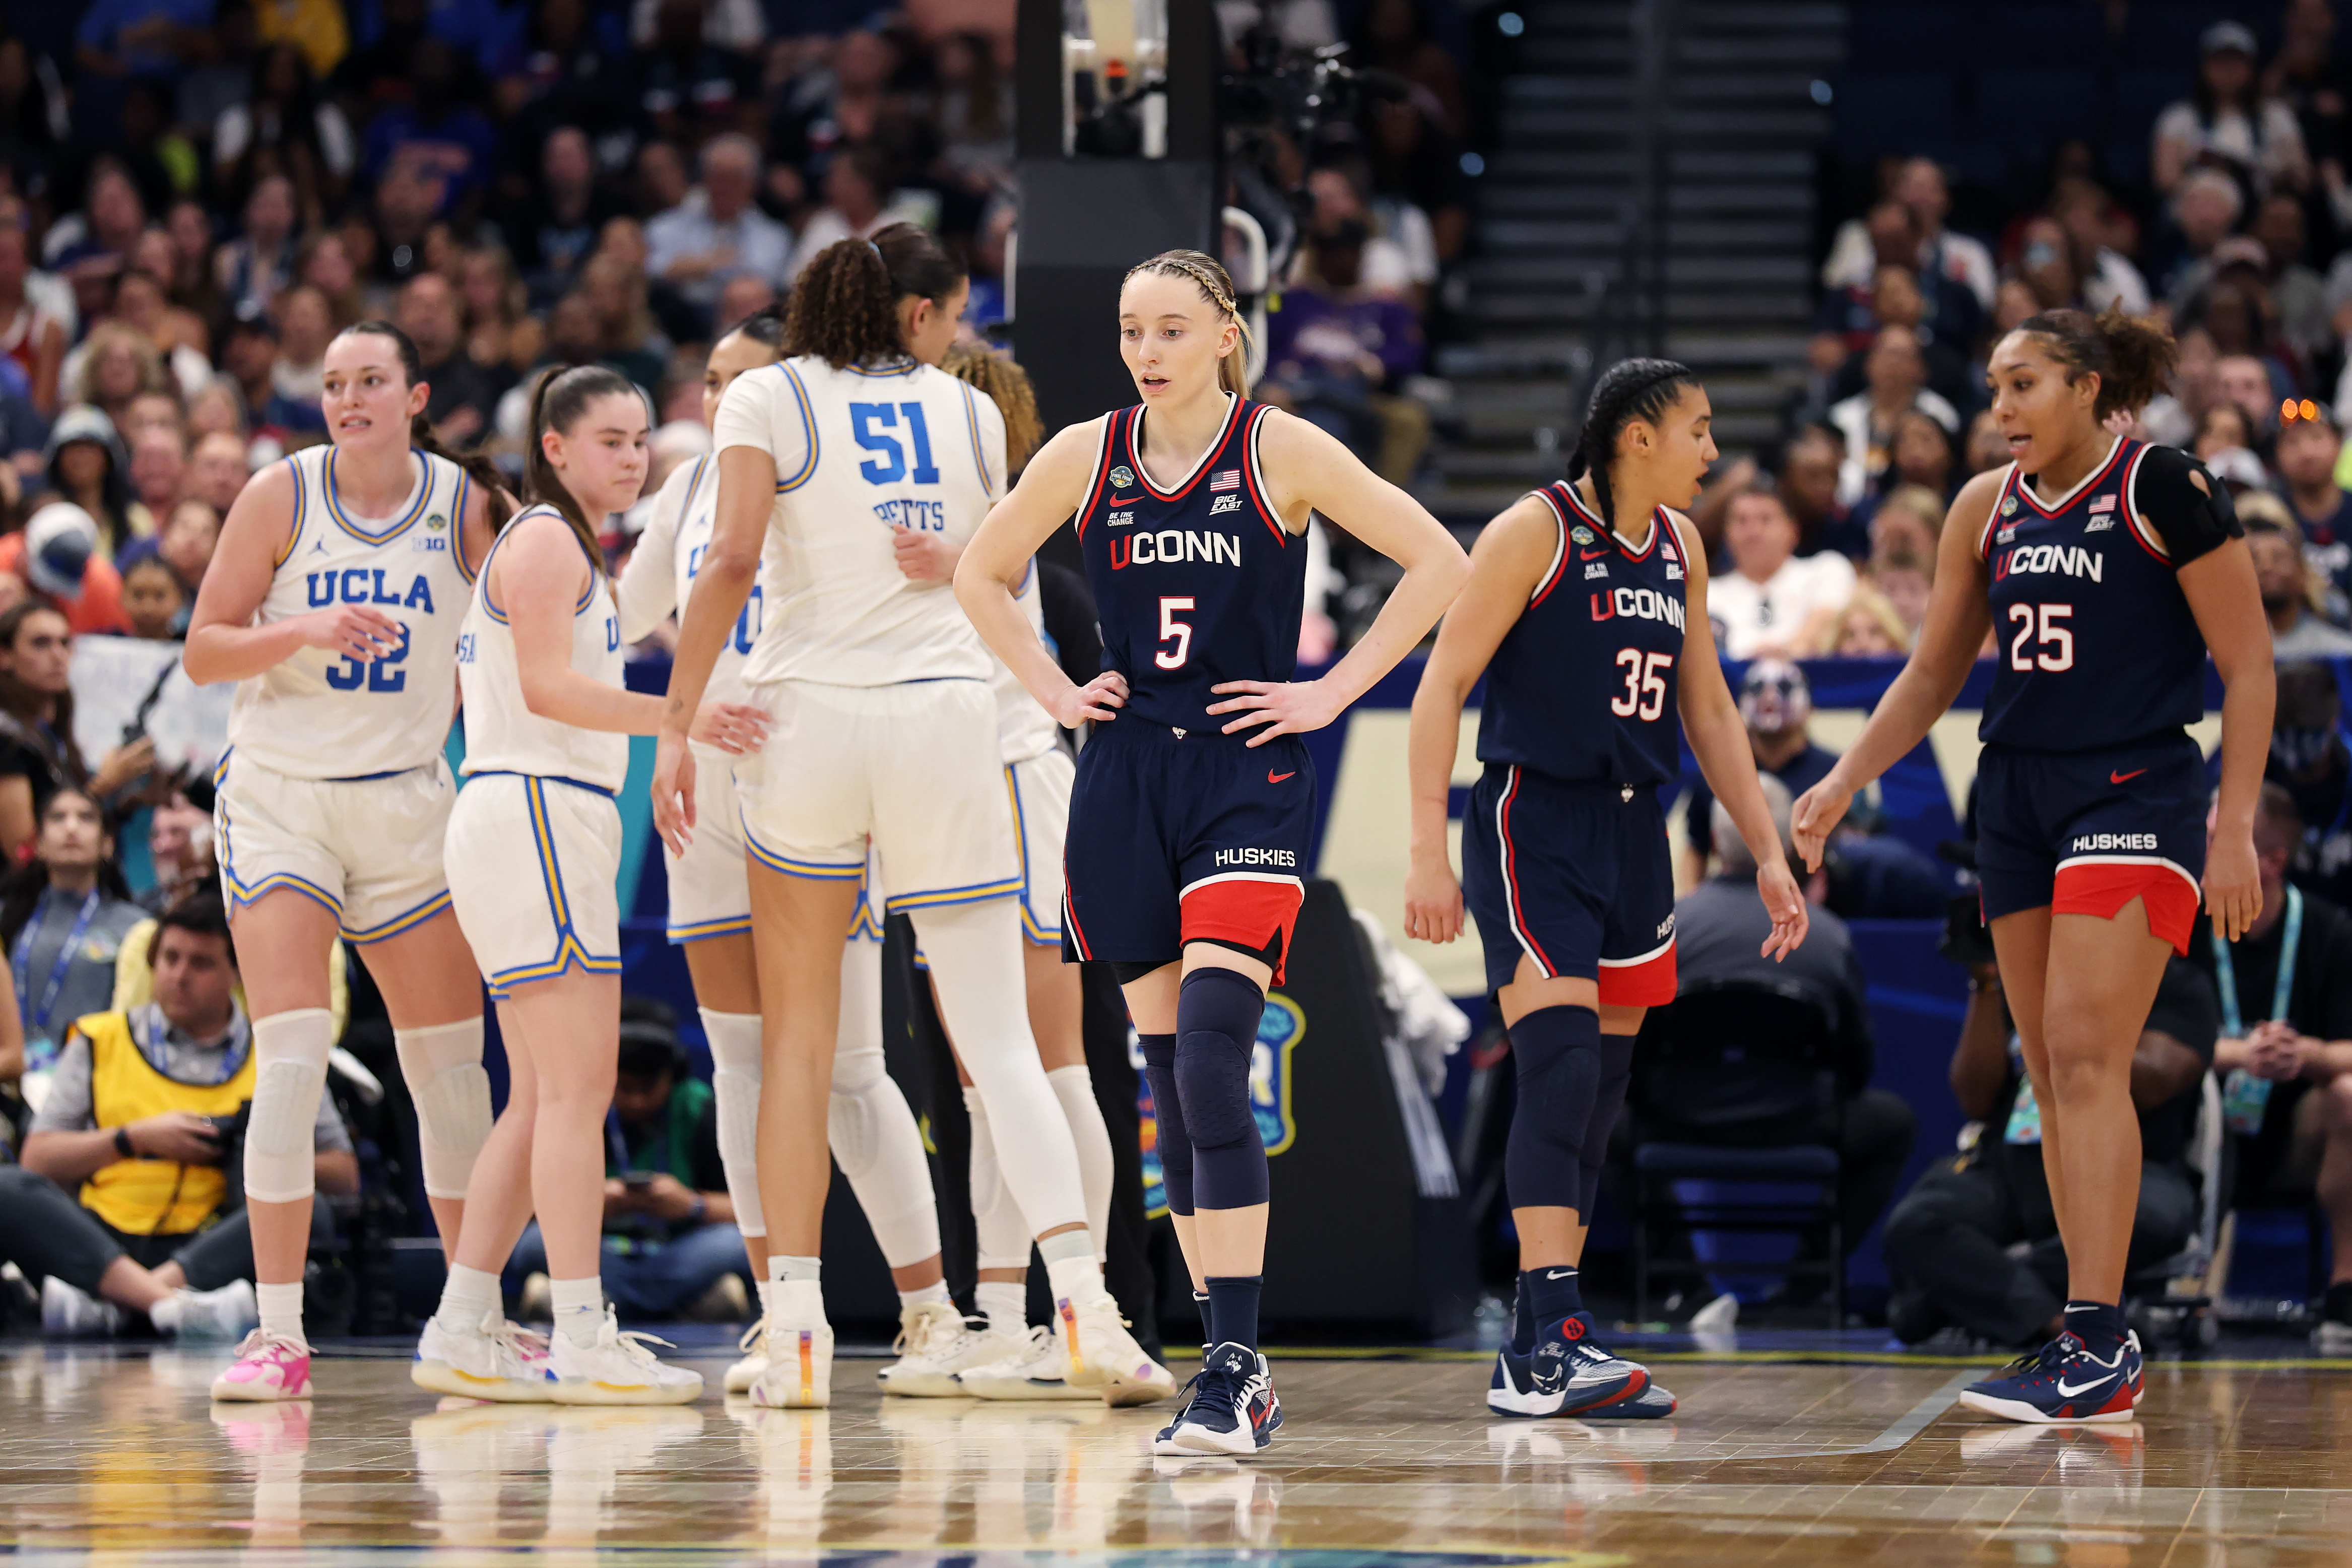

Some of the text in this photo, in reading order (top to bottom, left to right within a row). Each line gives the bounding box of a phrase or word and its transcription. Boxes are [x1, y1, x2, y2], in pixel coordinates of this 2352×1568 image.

[848, 402, 939, 485] 51
[1211, 500, 1243, 511] EAST
[1214, 494, 1237, 504] BIG
[1107, 517, 1134, 527] CHANGE
[1110, 530, 1241, 570] UCONN
[1995, 545, 2103, 583] UCONN
[307, 569, 434, 614] UCLA
[1590, 587, 1685, 635] UCONN
[1154, 596, 1196, 670] 5
[2008, 602, 2074, 672] 25
[1611, 647, 1673, 722] 35
[1215, 847, 1295, 867] HUSKIES
[2072, 833, 2158, 853] HUSKIES
